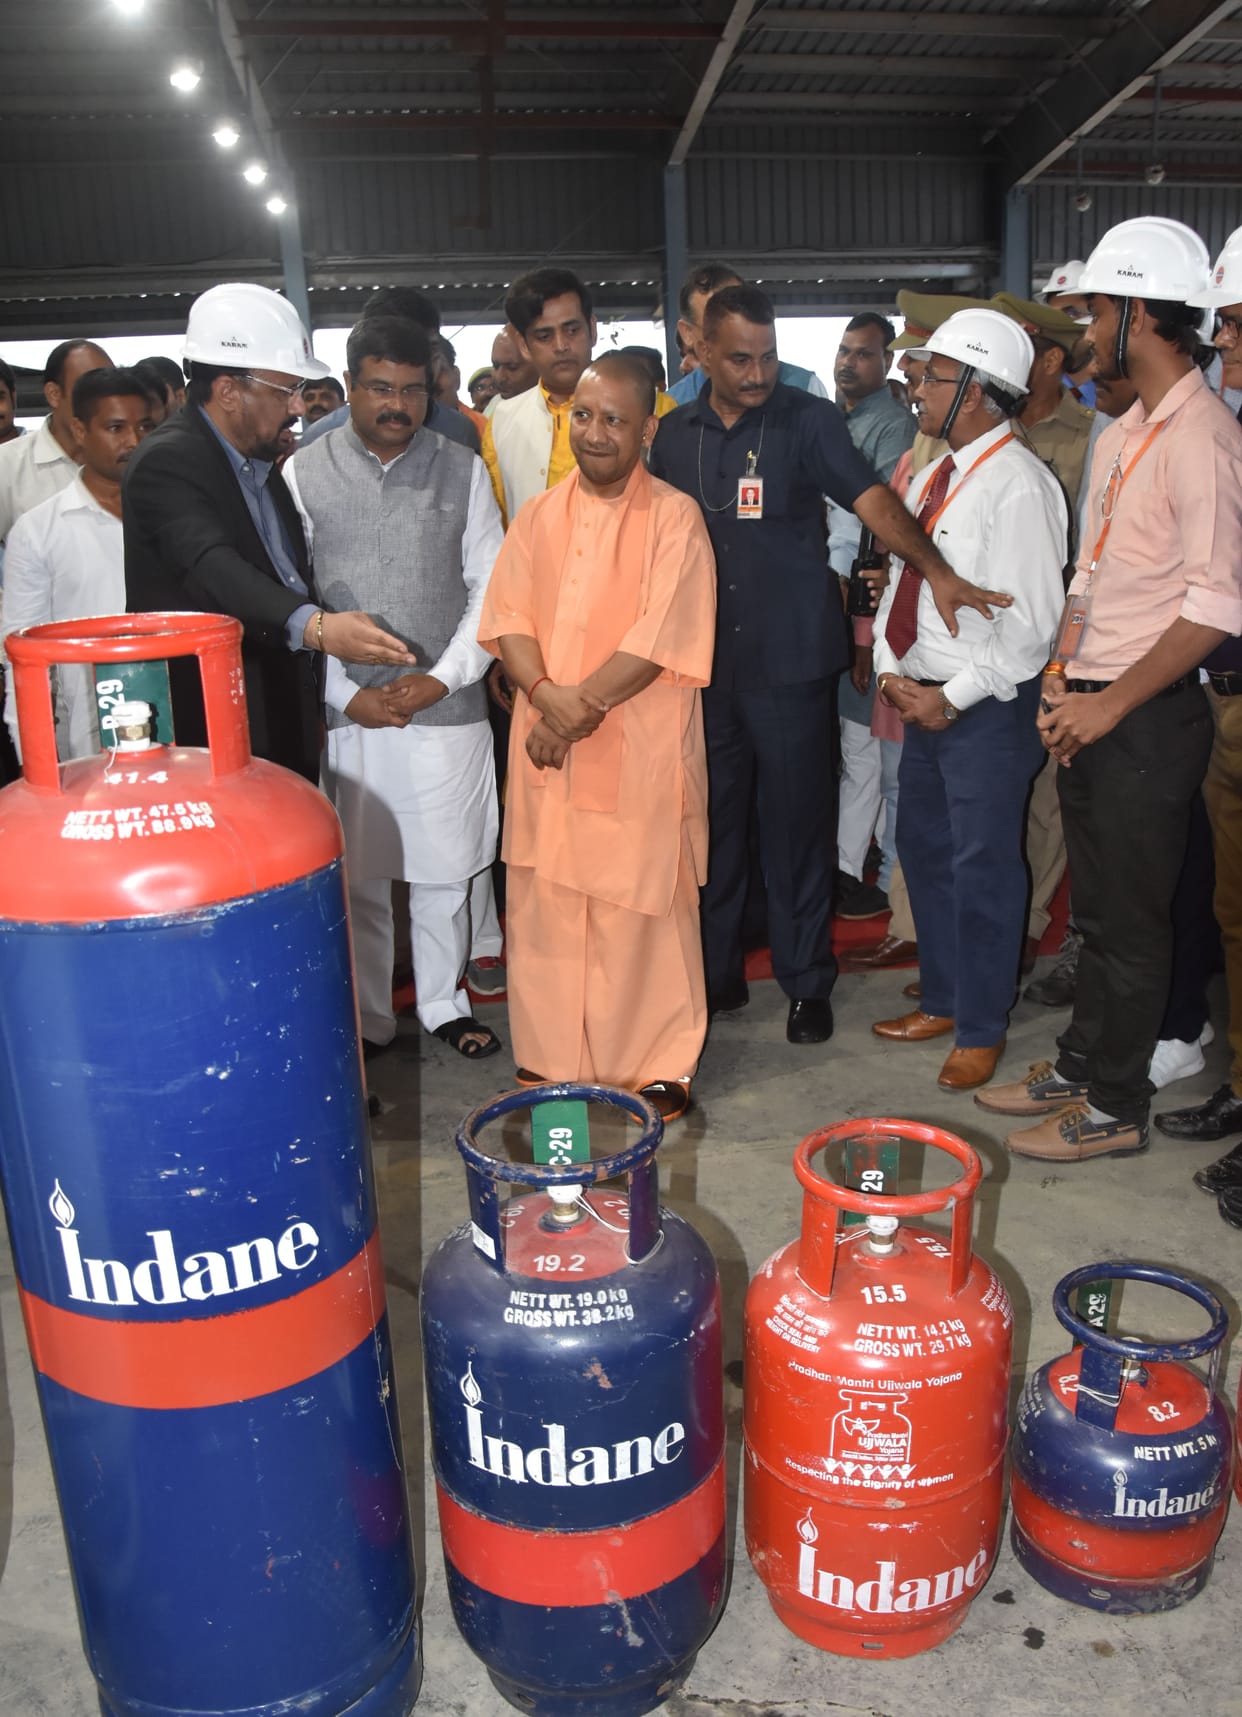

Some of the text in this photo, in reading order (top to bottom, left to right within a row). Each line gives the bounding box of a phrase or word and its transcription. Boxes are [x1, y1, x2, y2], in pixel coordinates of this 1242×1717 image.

[1117, 269, 1144, 279] KARAM
[96, 679, 126, 710] 29
[64, 801, 213, 825] NETT WT. 47.5 kg
[61, 823, 115, 840] GROSS
[117, 820, 150, 839] WT.
[191, 812, 216, 828] kg
[861, 1170, 884, 1192] 29
[56, 1222, 319, 1305] Indane
[533, 1254, 586, 1272] 19.2
[509, 1288, 629, 1309] NETT WT. 19.0 kg
[860, 1284, 907, 1305] 15.5
[503, 1307, 552, 1327] GROSS
[552, 1310, 580, 1327] WT.
[615, 1304, 635, 1320] kg
[857, 1319, 966, 1340] NETT WT. 14.2 kg
[854, 1333, 972, 1358] GROSS WT. 29.7 kg
[1147, 1401, 1181, 1423] 8.2
[463, 1403, 685, 1487] Indane
[1134, 1446, 1171, 1461] NETT
[1173, 1441, 1199, 1459] WT.
[1197, 1436, 1207, 1450] 5
[842, 1475, 862, 1487] the
[905, 1478, 915, 1488] of
[1111, 1485, 1214, 1518] Indane
[797, 1541, 987, 1614] Indane
